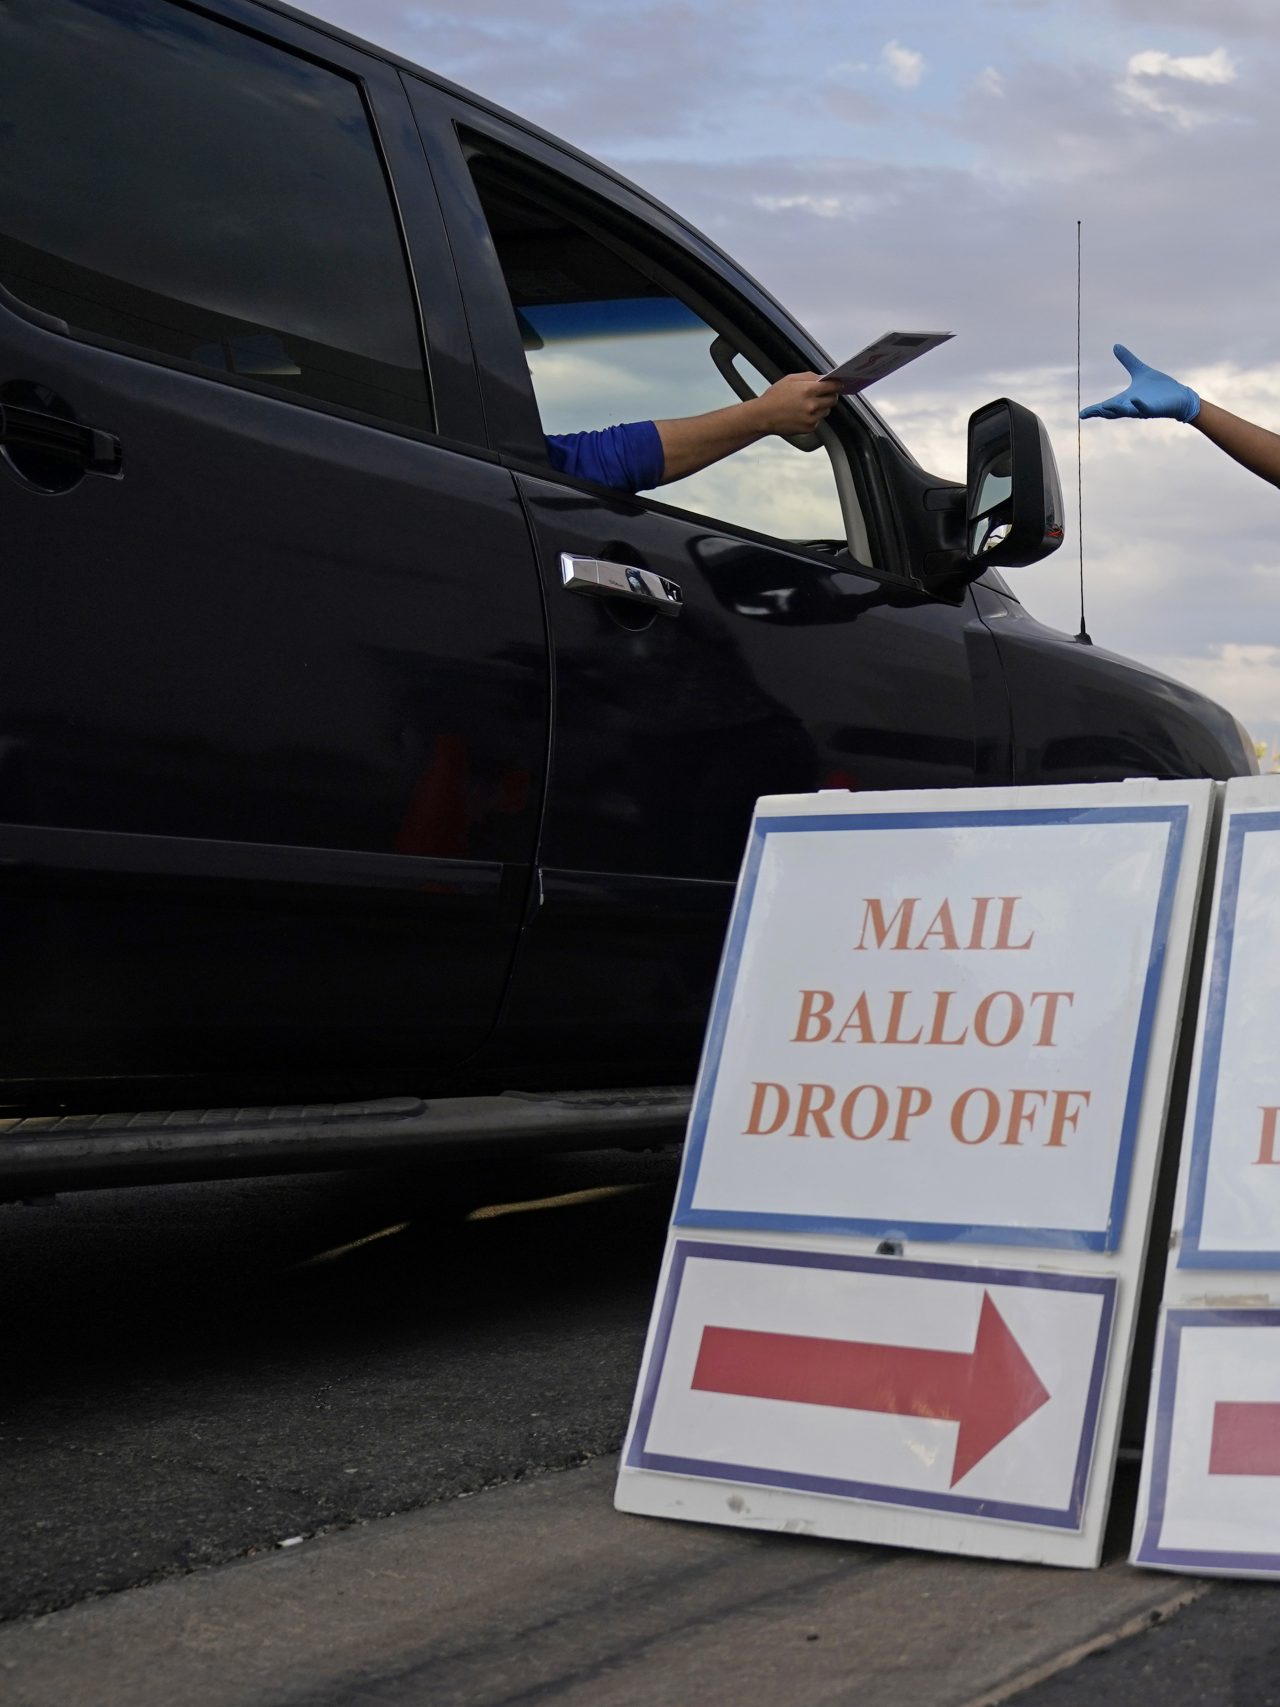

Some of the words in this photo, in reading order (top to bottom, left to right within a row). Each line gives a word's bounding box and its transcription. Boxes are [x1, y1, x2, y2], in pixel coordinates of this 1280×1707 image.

[853, 896, 1035, 952] MAIL
[789, 989, 1075, 1048] BALLOT
[741, 1081, 933, 1142] DROP
[949, 1087, 1092, 1148] OFF
